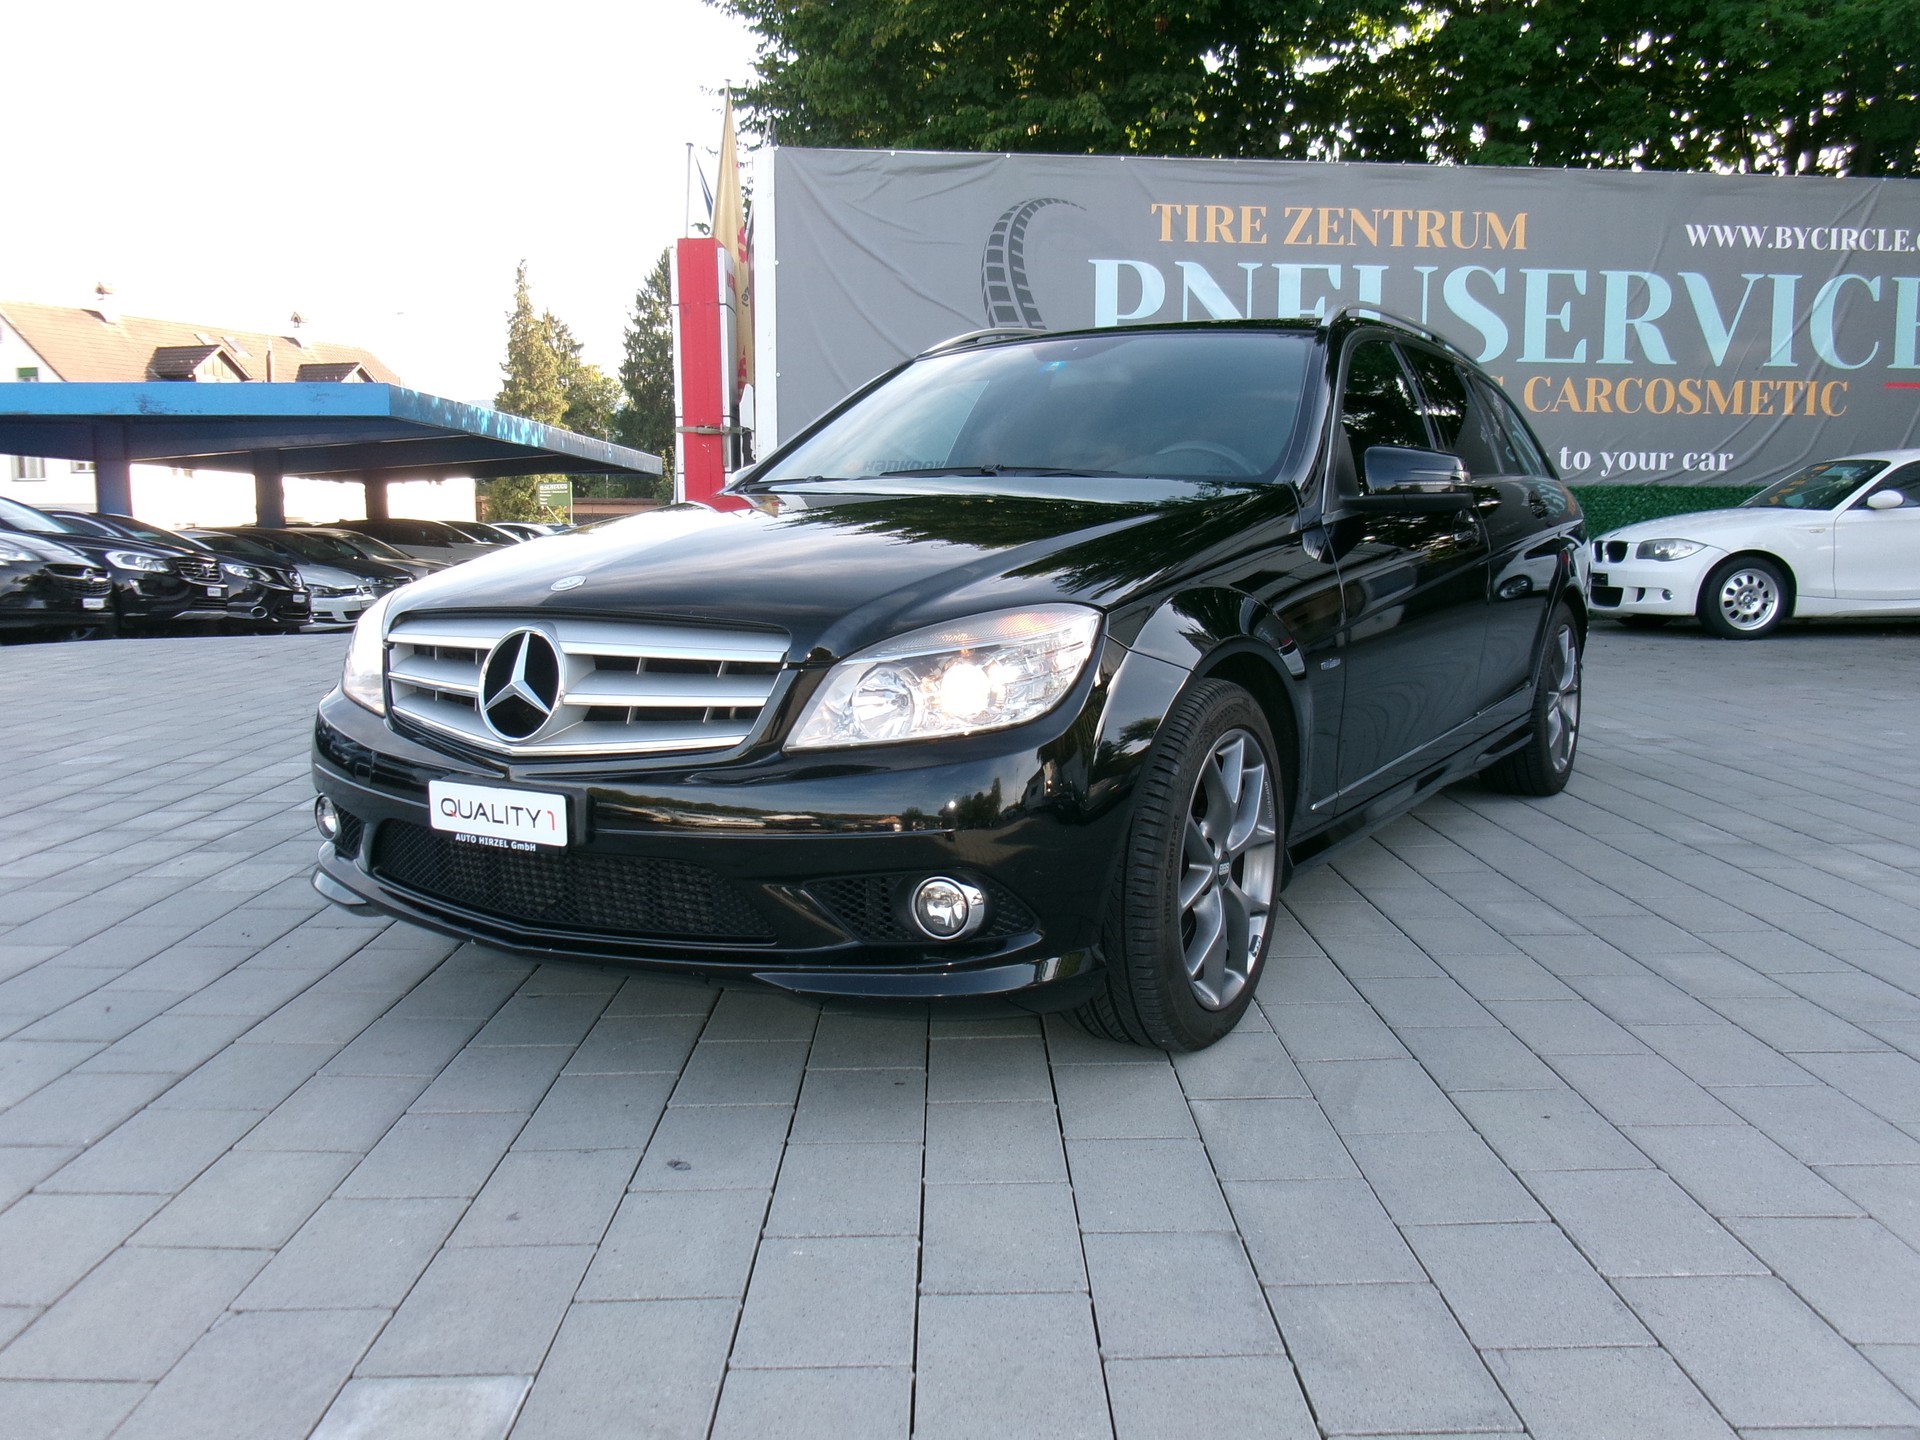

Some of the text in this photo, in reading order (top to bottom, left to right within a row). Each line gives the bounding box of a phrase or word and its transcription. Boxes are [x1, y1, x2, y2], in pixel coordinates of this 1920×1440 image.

[1150, 202, 1529, 251] TIRE ZENTRUM
[1684, 223, 1920, 253] WWW.BYCIRCLE.
[1523, 375, 1849, 417] CARCOSMETIC
[1558, 446, 1735, 477] to your car
[441, 798, 541, 828] QUALITY
[456, 834, 536, 852] AUTO HIRZEL GmbH
